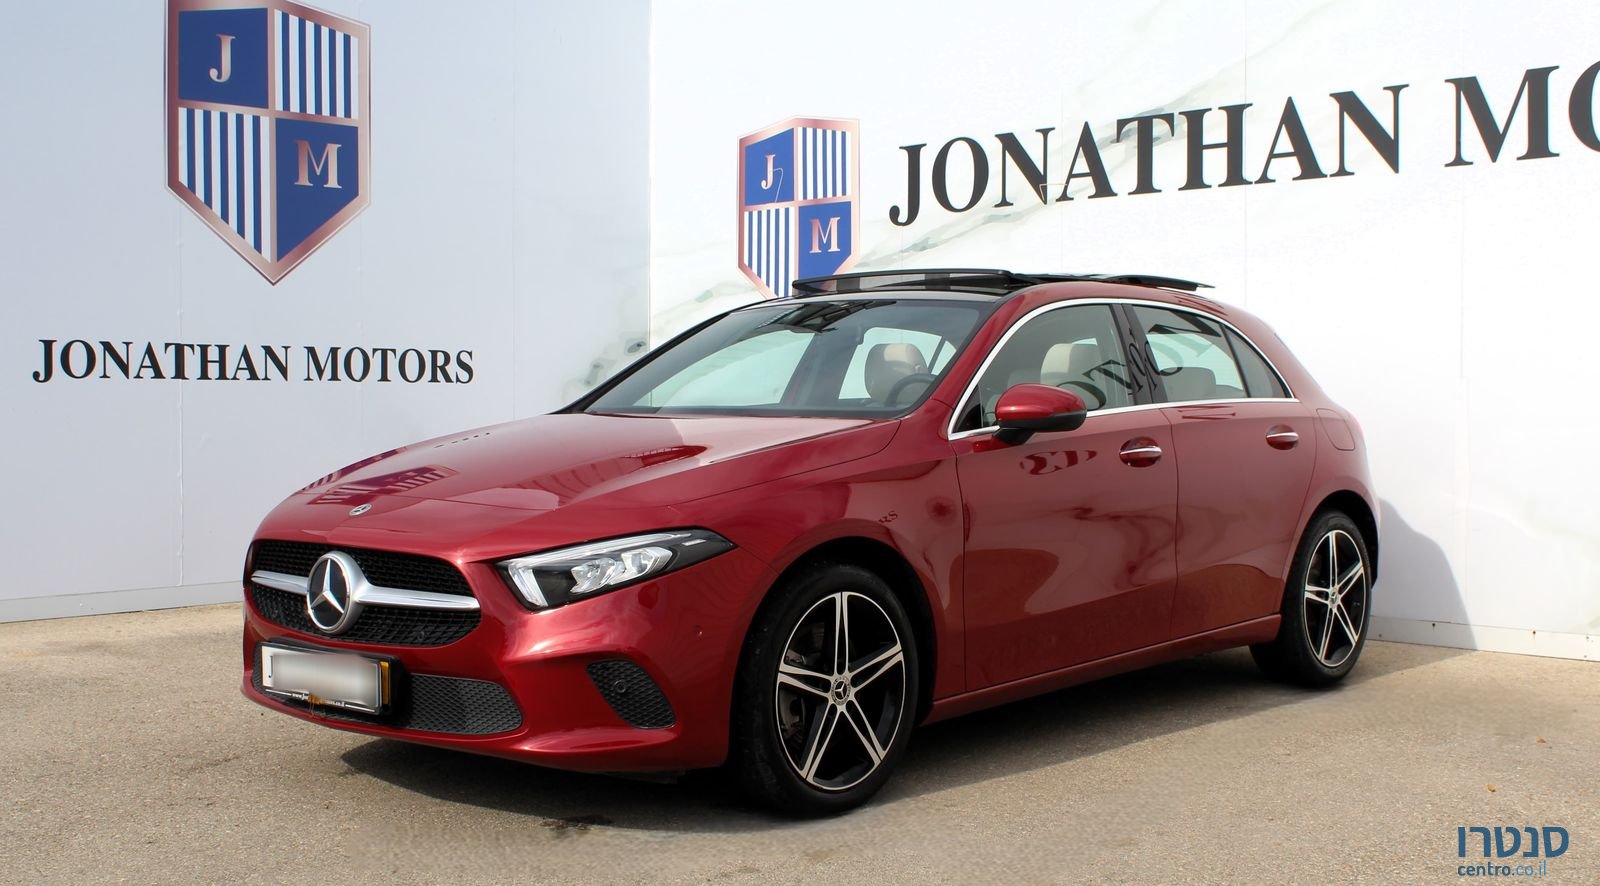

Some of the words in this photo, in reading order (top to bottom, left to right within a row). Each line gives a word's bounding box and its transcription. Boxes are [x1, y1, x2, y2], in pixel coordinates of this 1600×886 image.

[208, 33, 236, 84] J
[293, 139, 343, 190] M
[760, 153, 777, 191] J
[888, 84, 1410, 228] JONATHAN
[808, 216, 842, 254] M
[32, 339, 291, 384] JONATHAN
[303, 346, 474, 384] MOTORS
